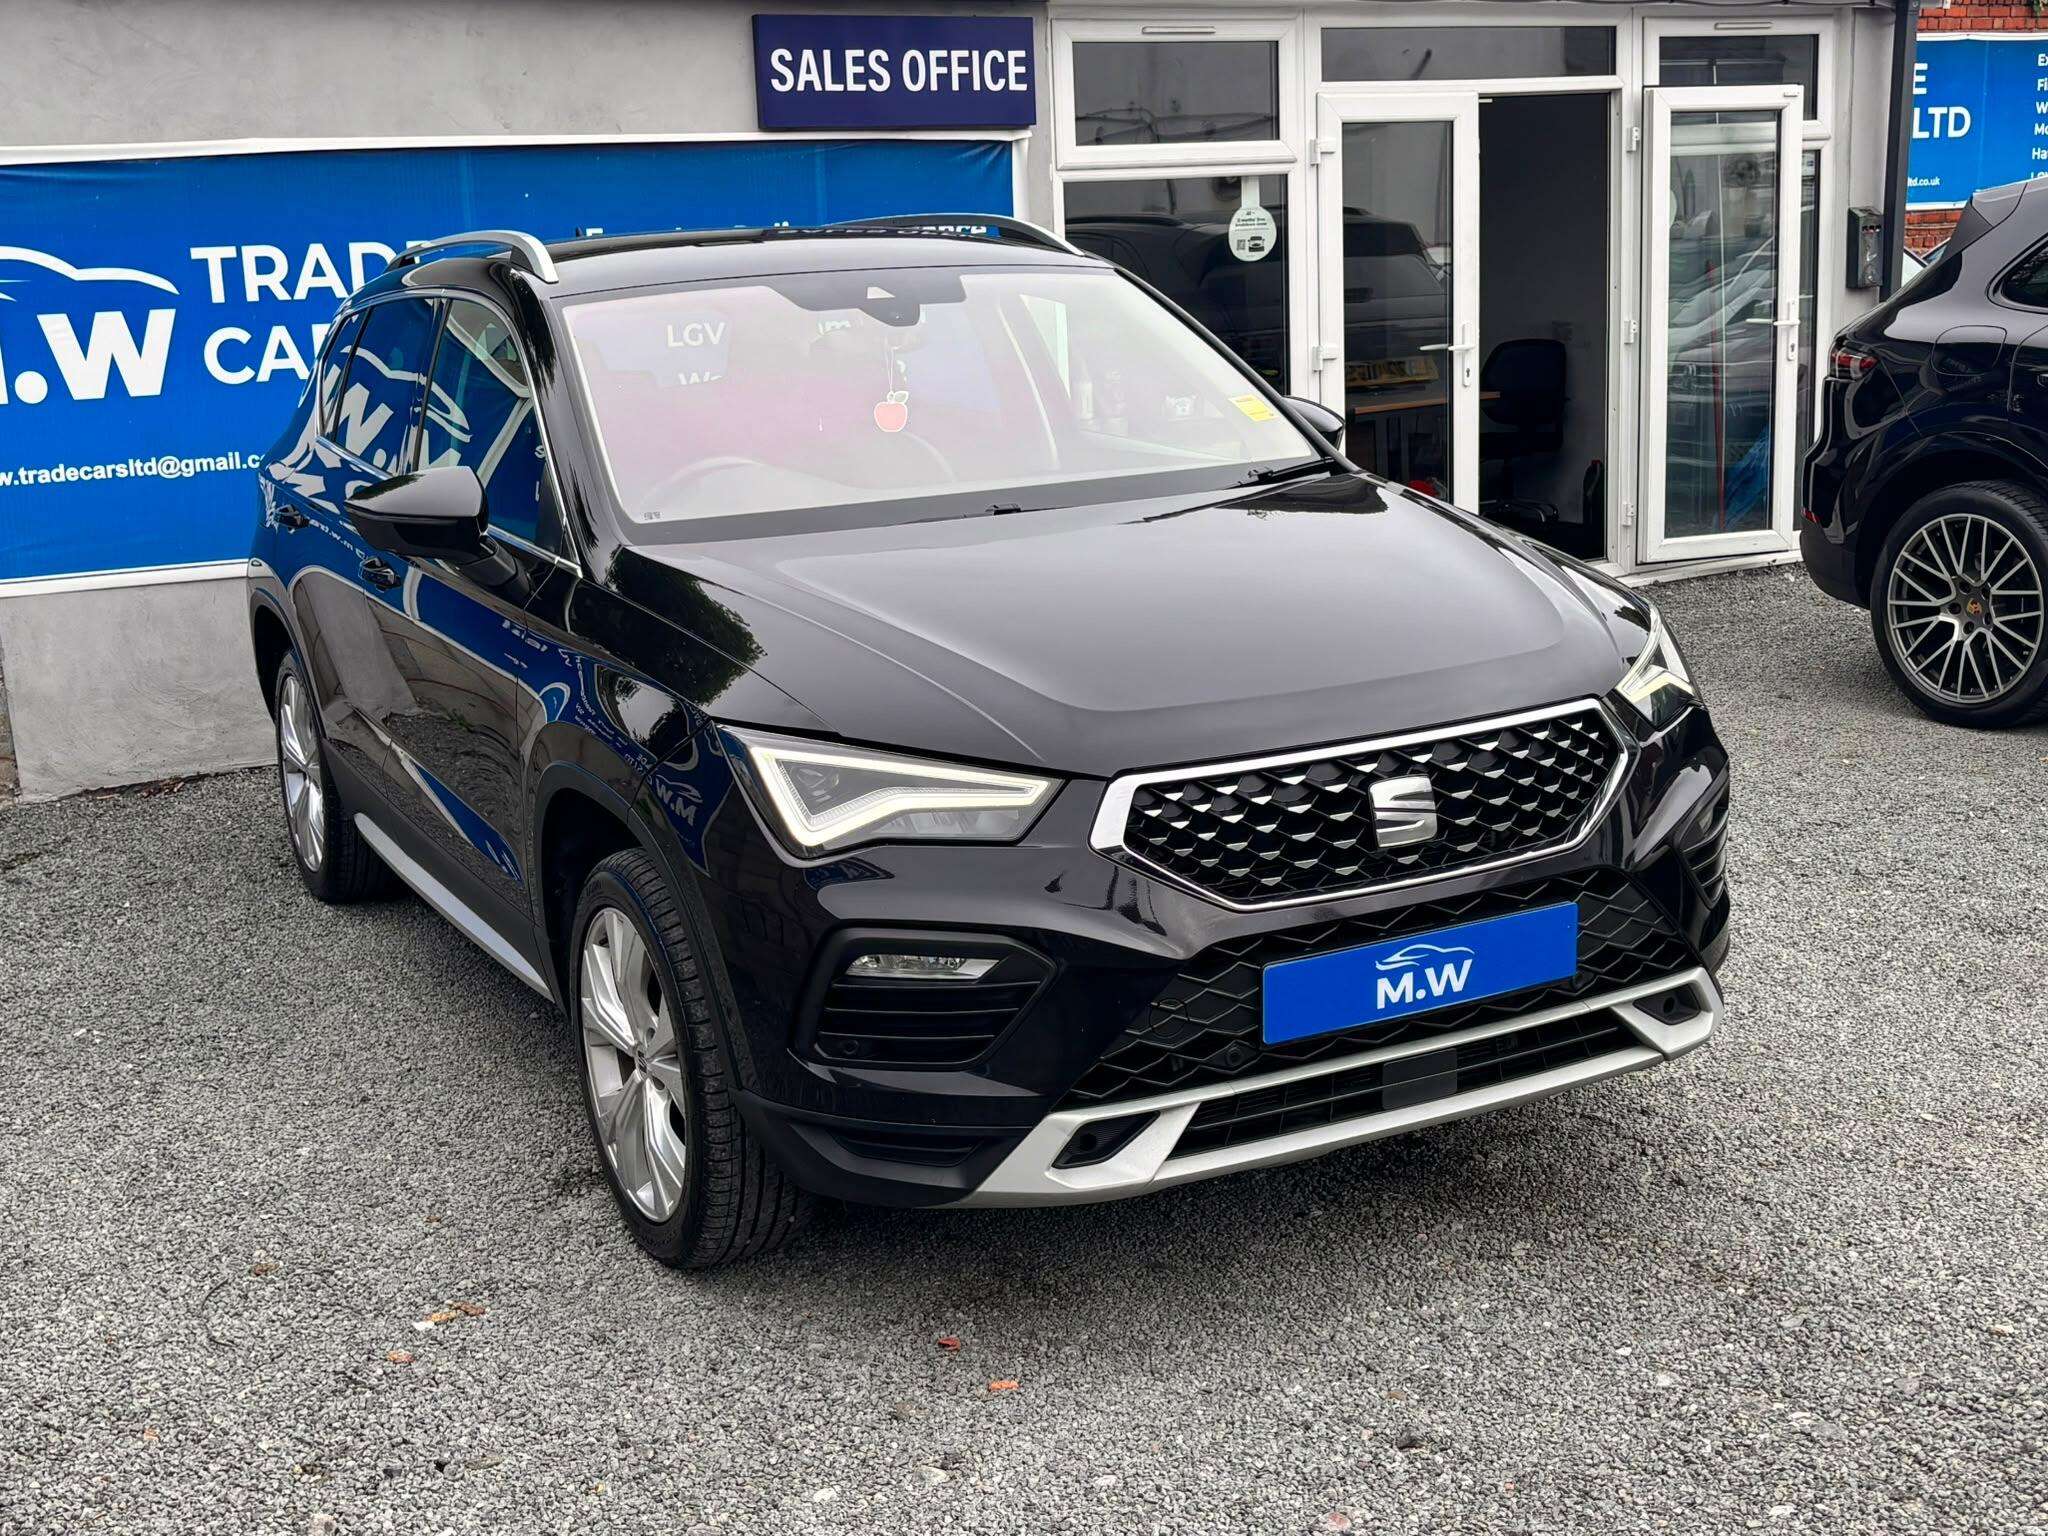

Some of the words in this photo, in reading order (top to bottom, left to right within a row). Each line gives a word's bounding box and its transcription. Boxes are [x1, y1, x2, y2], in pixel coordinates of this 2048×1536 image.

[770, 48, 891, 92] SALES
[902, 49, 1028, 92] OFFICE
[1912, 106, 1971, 139] LTD
[0, 308, 176, 405] .W
[203, 323, 332, 385] CA
[666, 321, 726, 348] LGV
[0, 451, 265, 487] w.tradecarsltd@gmail.c
[1376, 959, 1473, 1010] M.W
